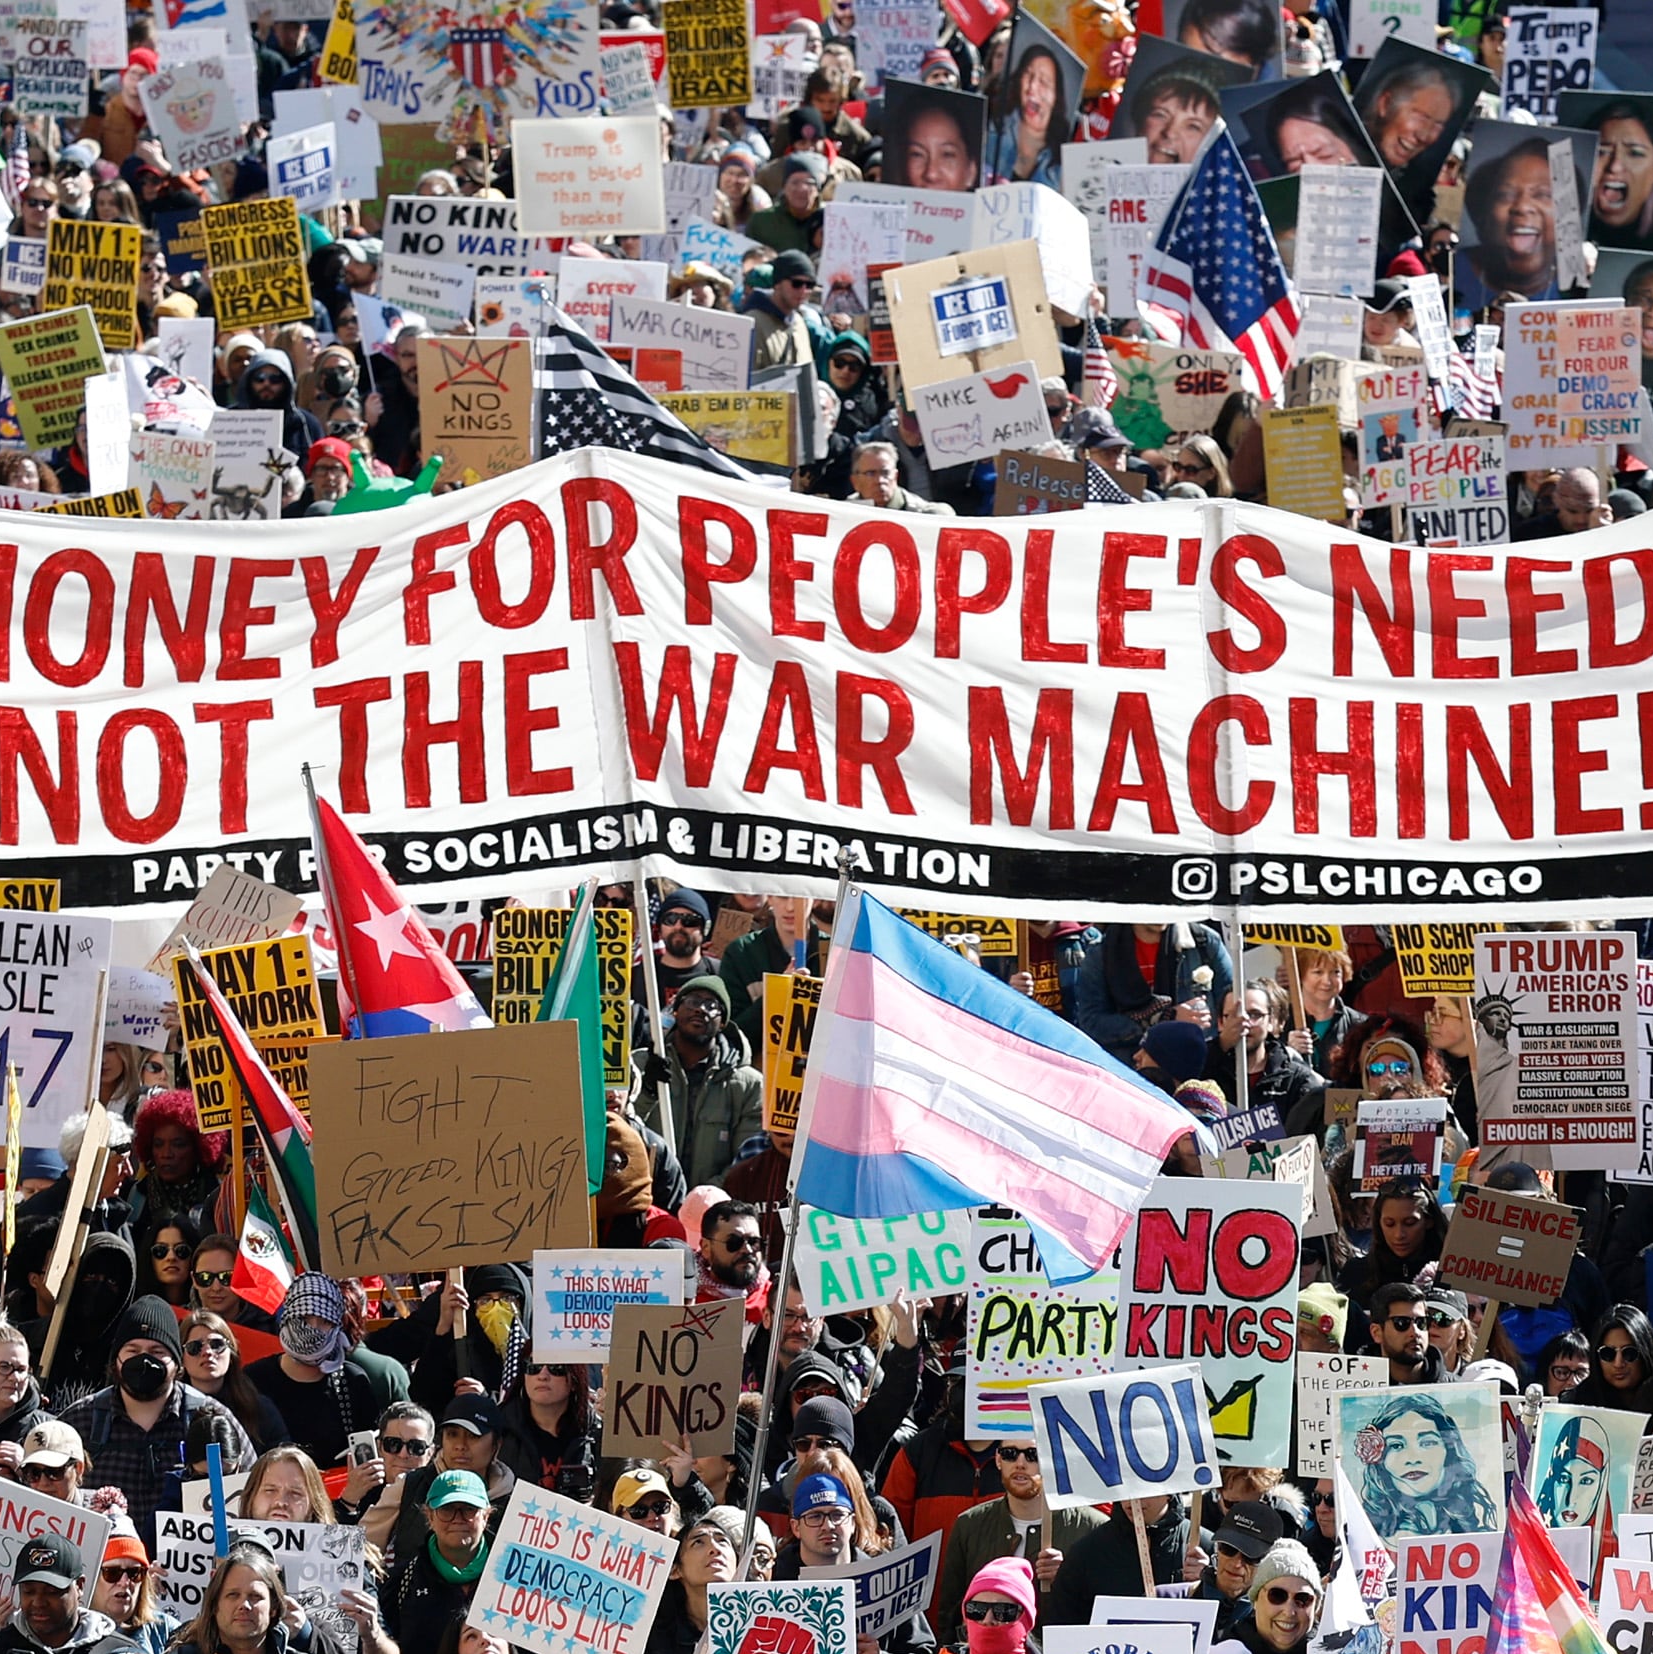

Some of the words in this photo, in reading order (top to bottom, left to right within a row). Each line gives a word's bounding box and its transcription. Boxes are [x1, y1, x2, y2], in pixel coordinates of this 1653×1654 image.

[361, 60, 422, 115] TRANS
[535, 74, 594, 116] KIDS
[1576, 311, 1615, 328] WITH
[1578, 335, 1616, 352] FEAR
[1564, 359, 1593, 373] FOR
[1597, 356, 1628, 373] OUR
[1560, 376, 1608, 394] DEMO
[452, 390, 500, 412] NO
[1581, 391, 1638, 412] CRACY
[444, 413, 511, 430] KINGS
[1570, 418, 1640, 436] DISSENT
[404, 478, 642, 645] FOR
[677, 497, 1286, 674] PEOPLE'S
[314, 648, 573, 813] THE
[610, 641, 916, 815] WAR
[133, 849, 280, 893] PARTY
[405, 813, 658, 874] SOCIALISM
[668, 819, 695, 855] &
[710, 823, 989, 887] LIBERATION
[1230, 861, 1542, 899] PSLCHICAGO
[1485, 941, 1624, 973] TRUMP
[1516, 974, 1627, 994] AMERICA'S
[1549, 992, 1621, 1012] ERROR
[1523, 1023, 1545, 1036] WAR
[1548, 1023, 1553, 1036] &
[1556, 1023, 1616, 1035] GASLIGHTING
[1524, 1054, 1559, 1065] STEALS
[1562, 1054, 1588, 1065] YOUR
[1592, 1054, 1622, 1065] VOTES
[1522, 1071, 1562, 1082] MASSIVE
[1564, 1071, 1621, 1082] CORRUPTION
[1520, 1087, 1595, 1099] CONSTITUTIONAL
[1598, 1087, 1626, 1098] CRISIS
[1487, 1123, 1547, 1142] ENOUGH
[1551, 1123, 1564, 1141] is
[1567, 1122, 1633, 1141] ENOUGH!
[1041, 1377, 1213, 1495] NO!
[517, 1514, 561, 1550] THIS
[571, 1528, 596, 1561] IS
[600, 1540, 665, 1588] WHAT
[504, 1549, 636, 1615] DEMOCRACY
[496, 1584, 569, 1632] LOOKS
